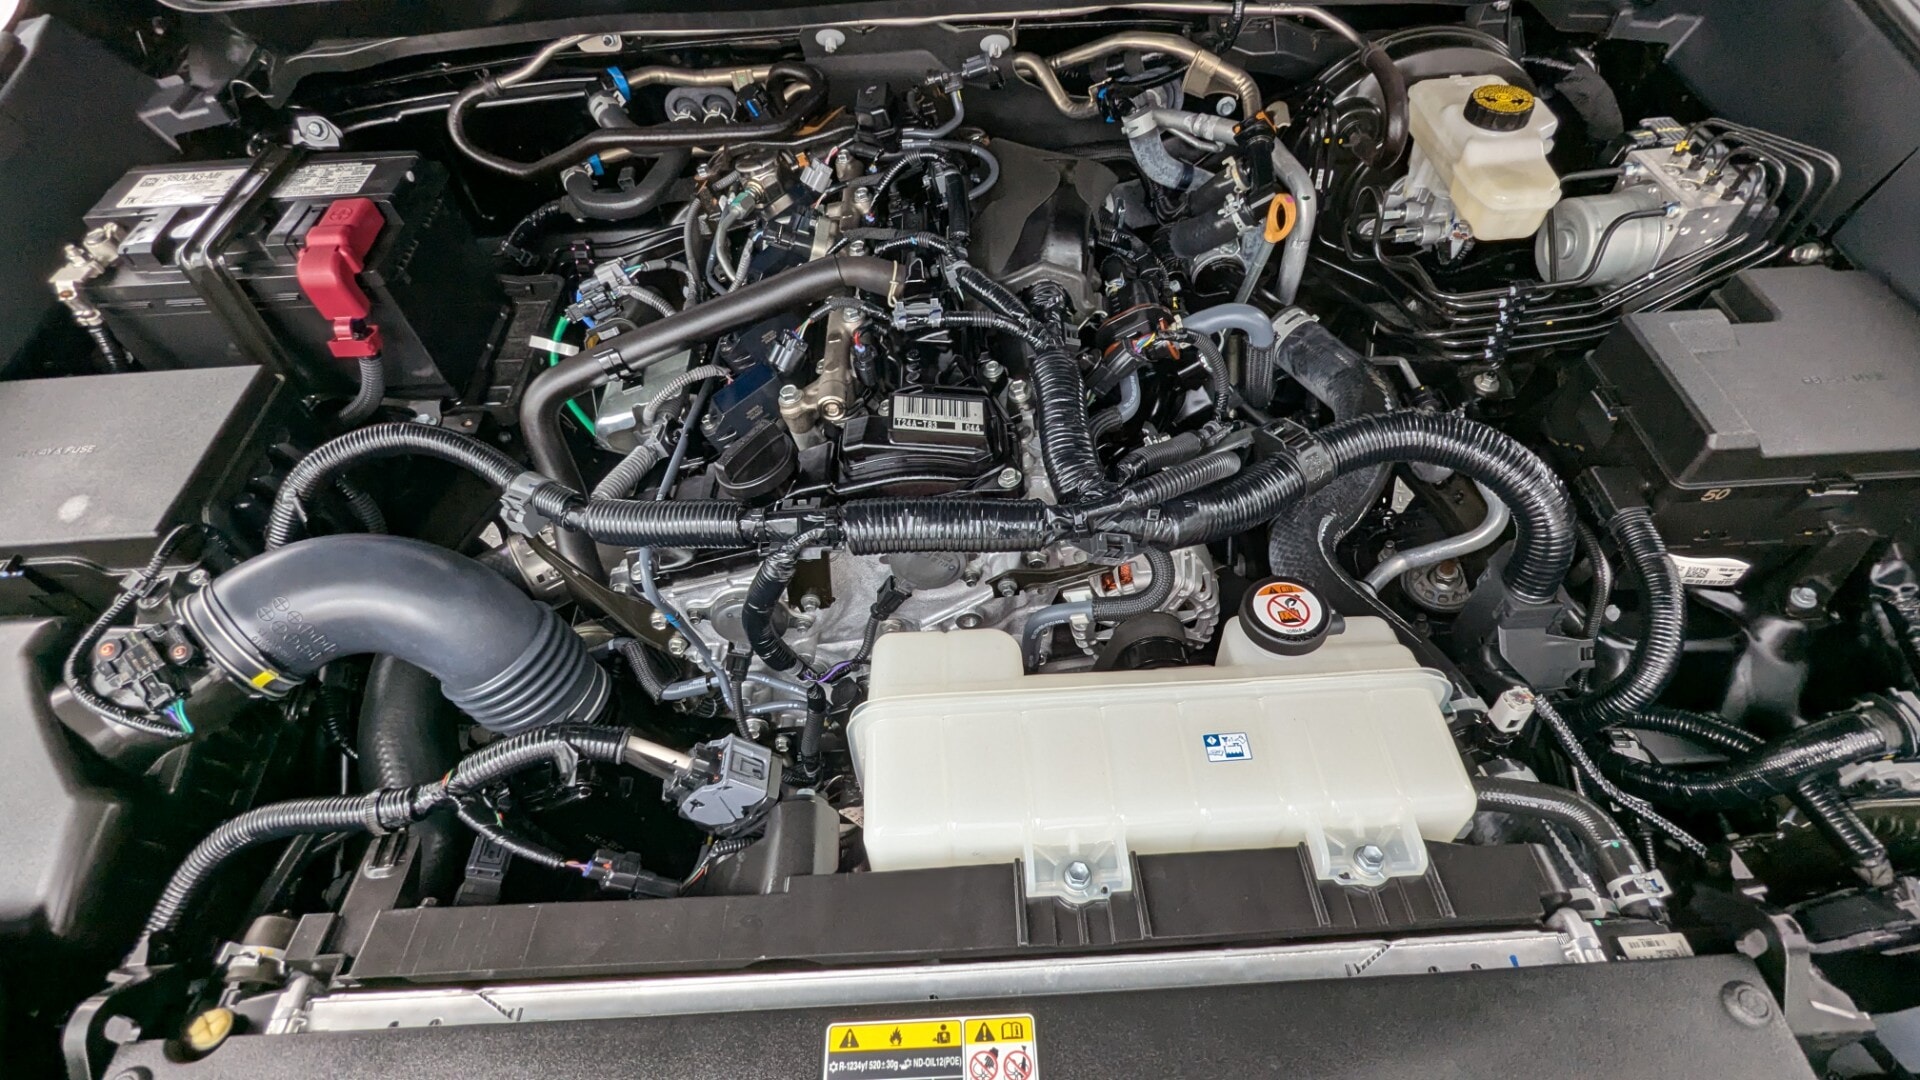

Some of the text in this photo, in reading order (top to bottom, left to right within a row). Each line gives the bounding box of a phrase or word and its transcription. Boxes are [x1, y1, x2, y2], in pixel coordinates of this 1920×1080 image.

[896, 418, 938, 430] T24A-T83
[965, 424, 981, 433] 044
[1701, 488, 1731, 501] 50
[839, 1060, 868, 1073] R-1234yf
[913, 1056, 962, 1069] ND-OIL12(POE)
